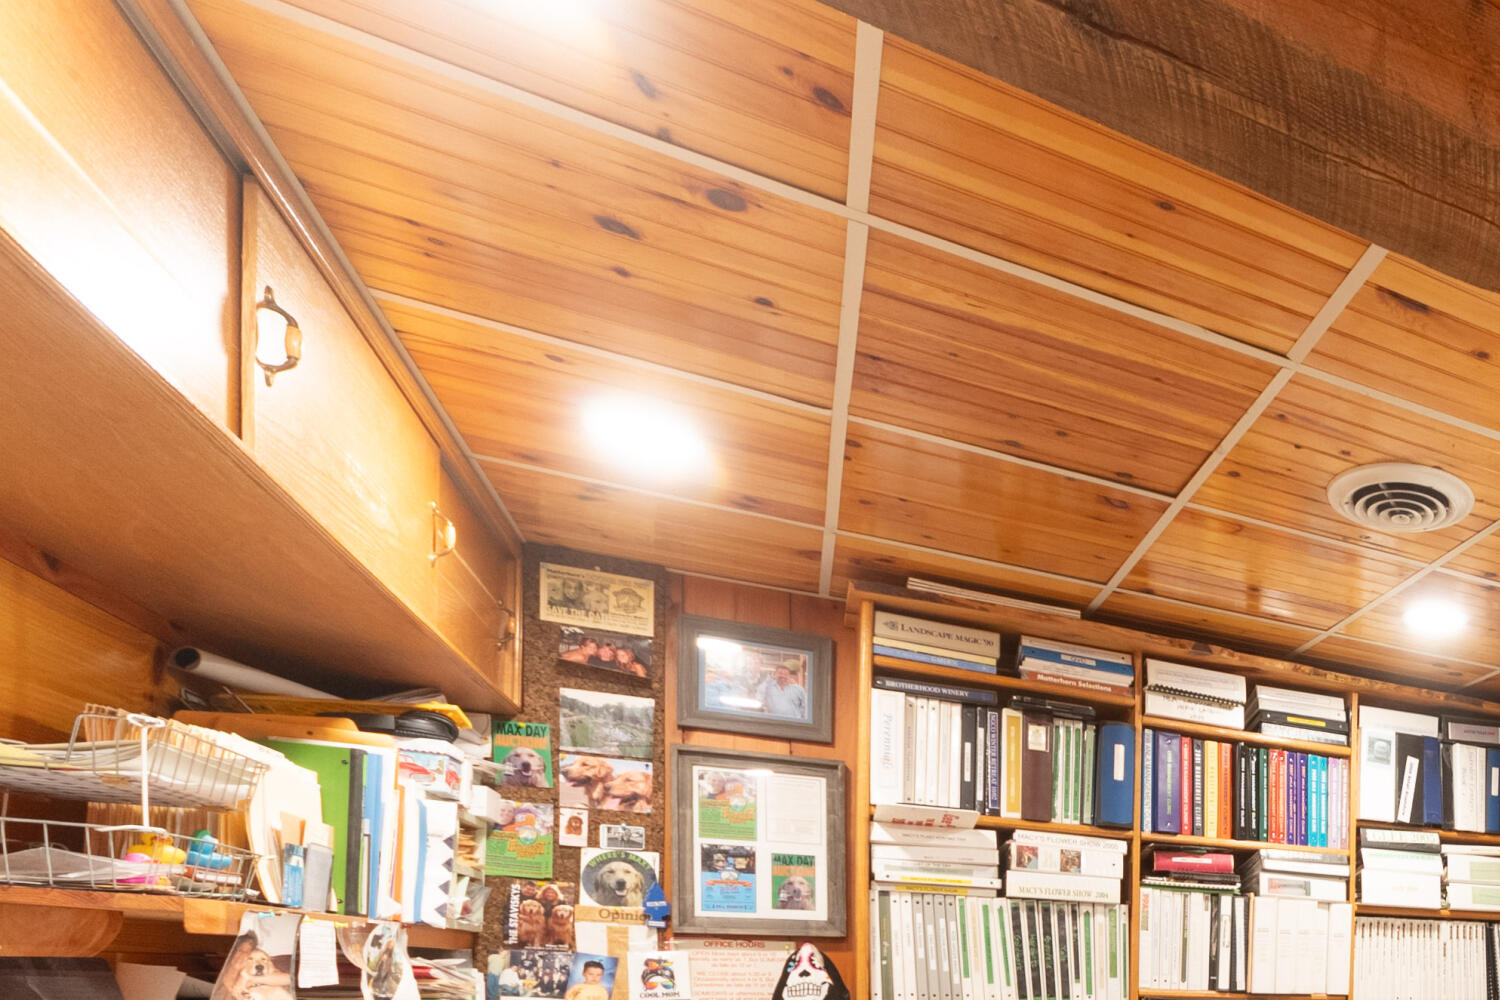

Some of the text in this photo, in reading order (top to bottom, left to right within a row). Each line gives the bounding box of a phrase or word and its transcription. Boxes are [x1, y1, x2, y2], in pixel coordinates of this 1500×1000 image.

[885, 679, 969, 697] BROTHERHOOD WINERY
[1036, 673, 1112, 692] Matterhorn Selections
[496, 722, 548, 738] MAX DAY
[774, 855, 815, 867] MAX DAY
[1018, 886, 1044, 894] MACY'S
[1044, 888, 1071, 897] FLOWER
[509, 884, 521, 945] THE STAVISKYS
[598, 907, 647, 921] Opinio
[703, 940, 766, 949] OFFICE HOURS
[638, 990, 680, 999] COOL MOM
